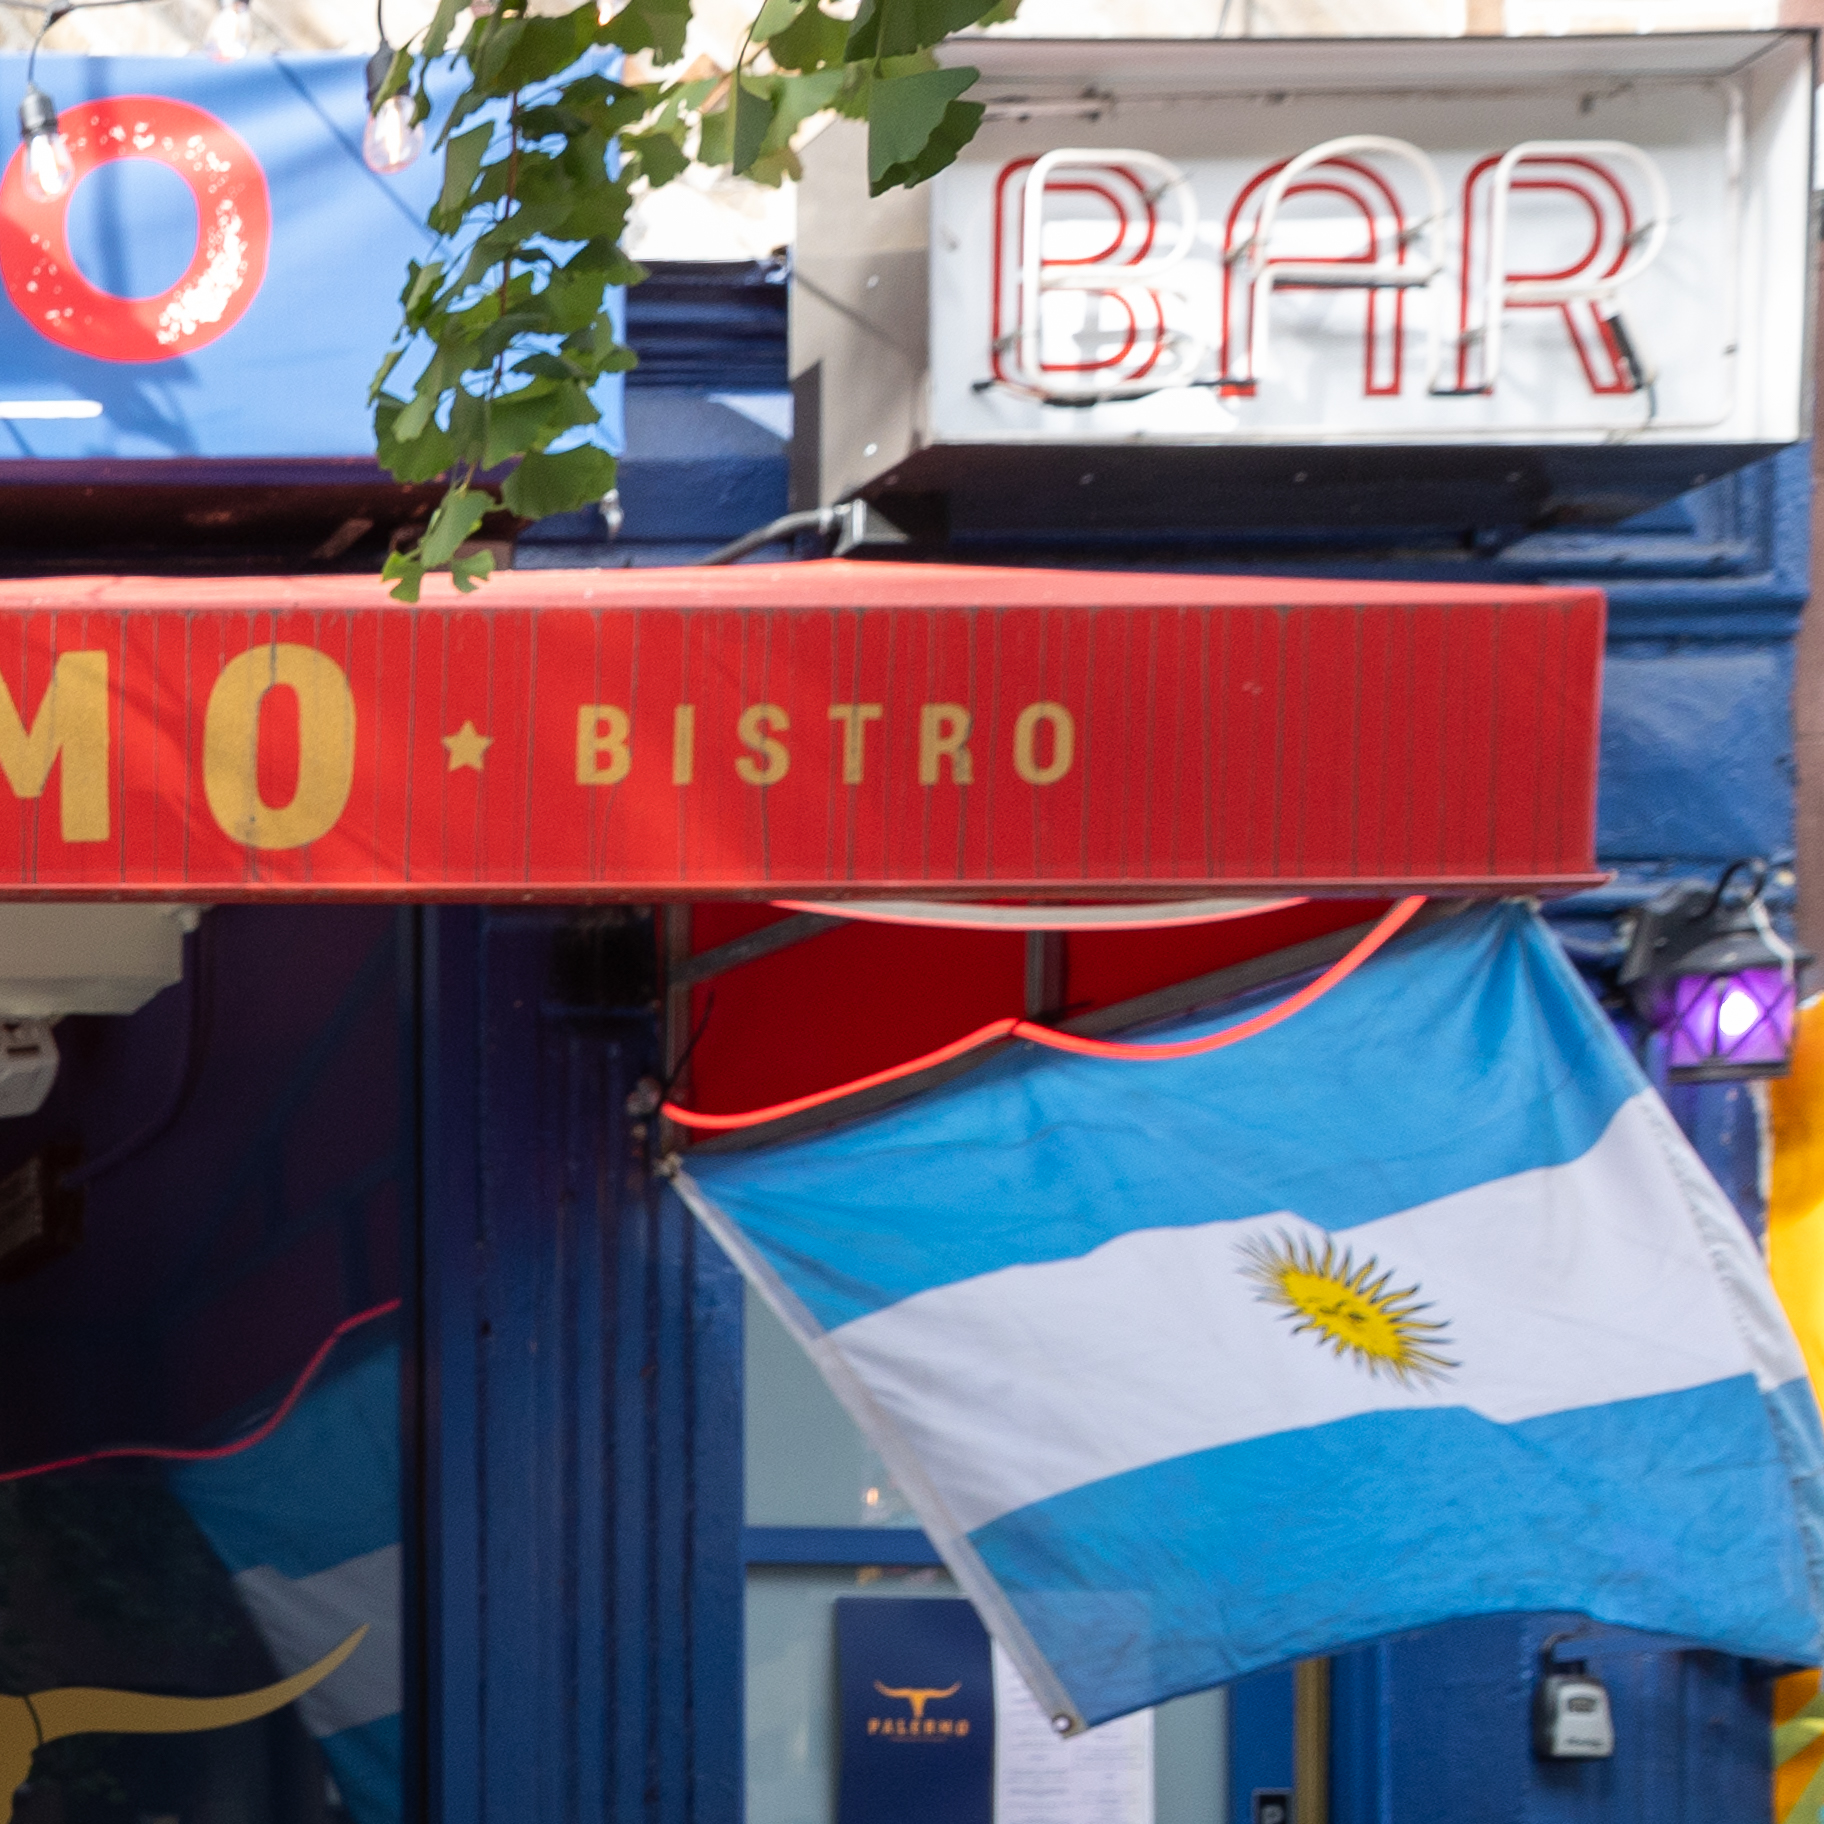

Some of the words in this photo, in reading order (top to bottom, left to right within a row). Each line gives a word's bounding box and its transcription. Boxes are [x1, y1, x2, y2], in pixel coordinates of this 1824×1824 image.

[990, 134, 1668, 402] BAR
[574, 700, 1077, 788] BISTRO
[867, 1717, 971, 1737] PALERMO
